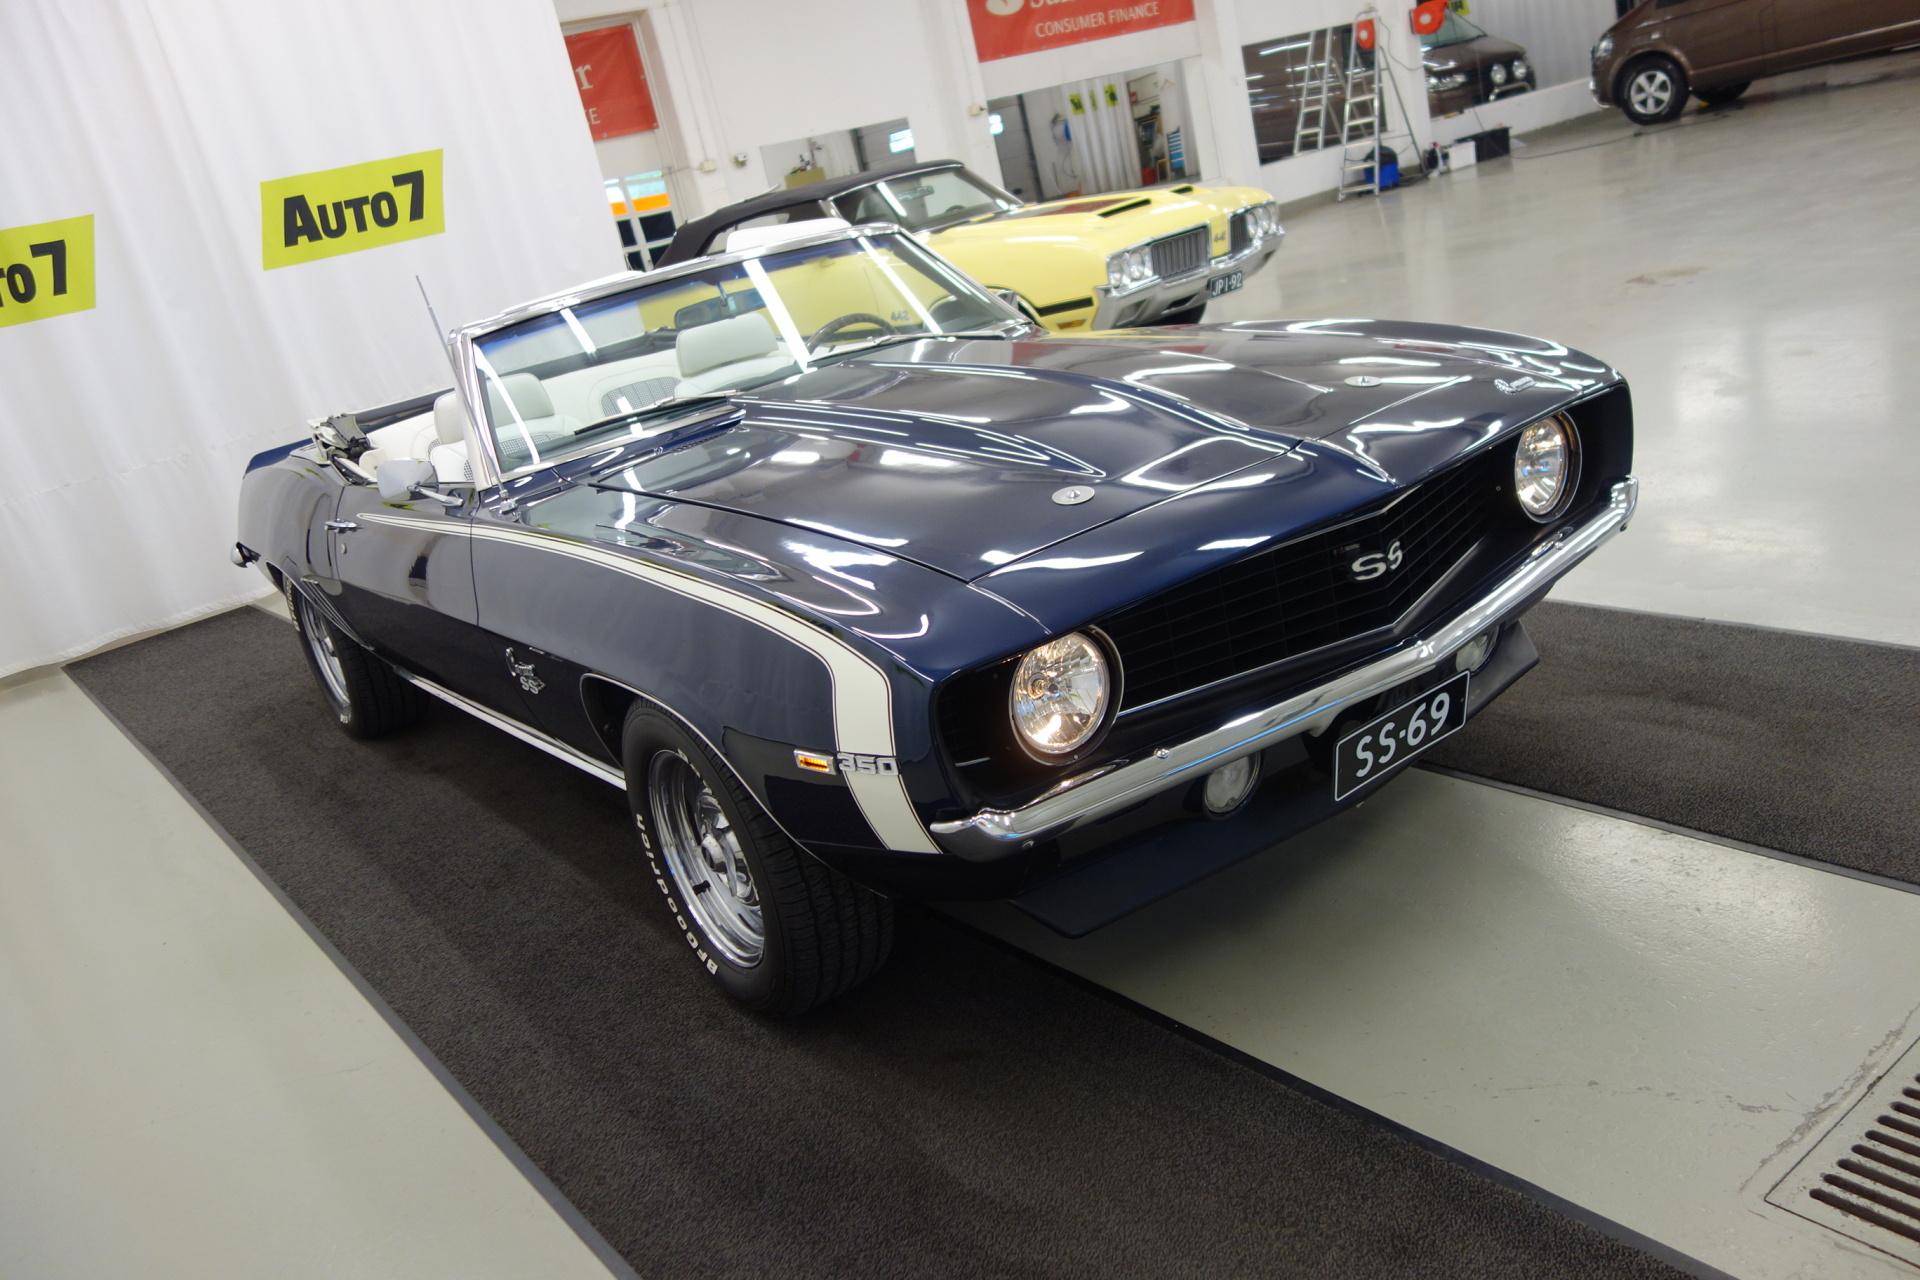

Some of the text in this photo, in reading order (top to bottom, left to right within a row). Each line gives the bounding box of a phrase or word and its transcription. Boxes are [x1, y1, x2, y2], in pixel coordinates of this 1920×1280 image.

[1034, 2, 1160, 38] CONSUMER FINANCE
[1351, 541, 1403, 581] SS
[519, 676, 539, 695] SS
[1355, 692, 1450, 778] SS-69
[836, 752, 899, 776] 350
